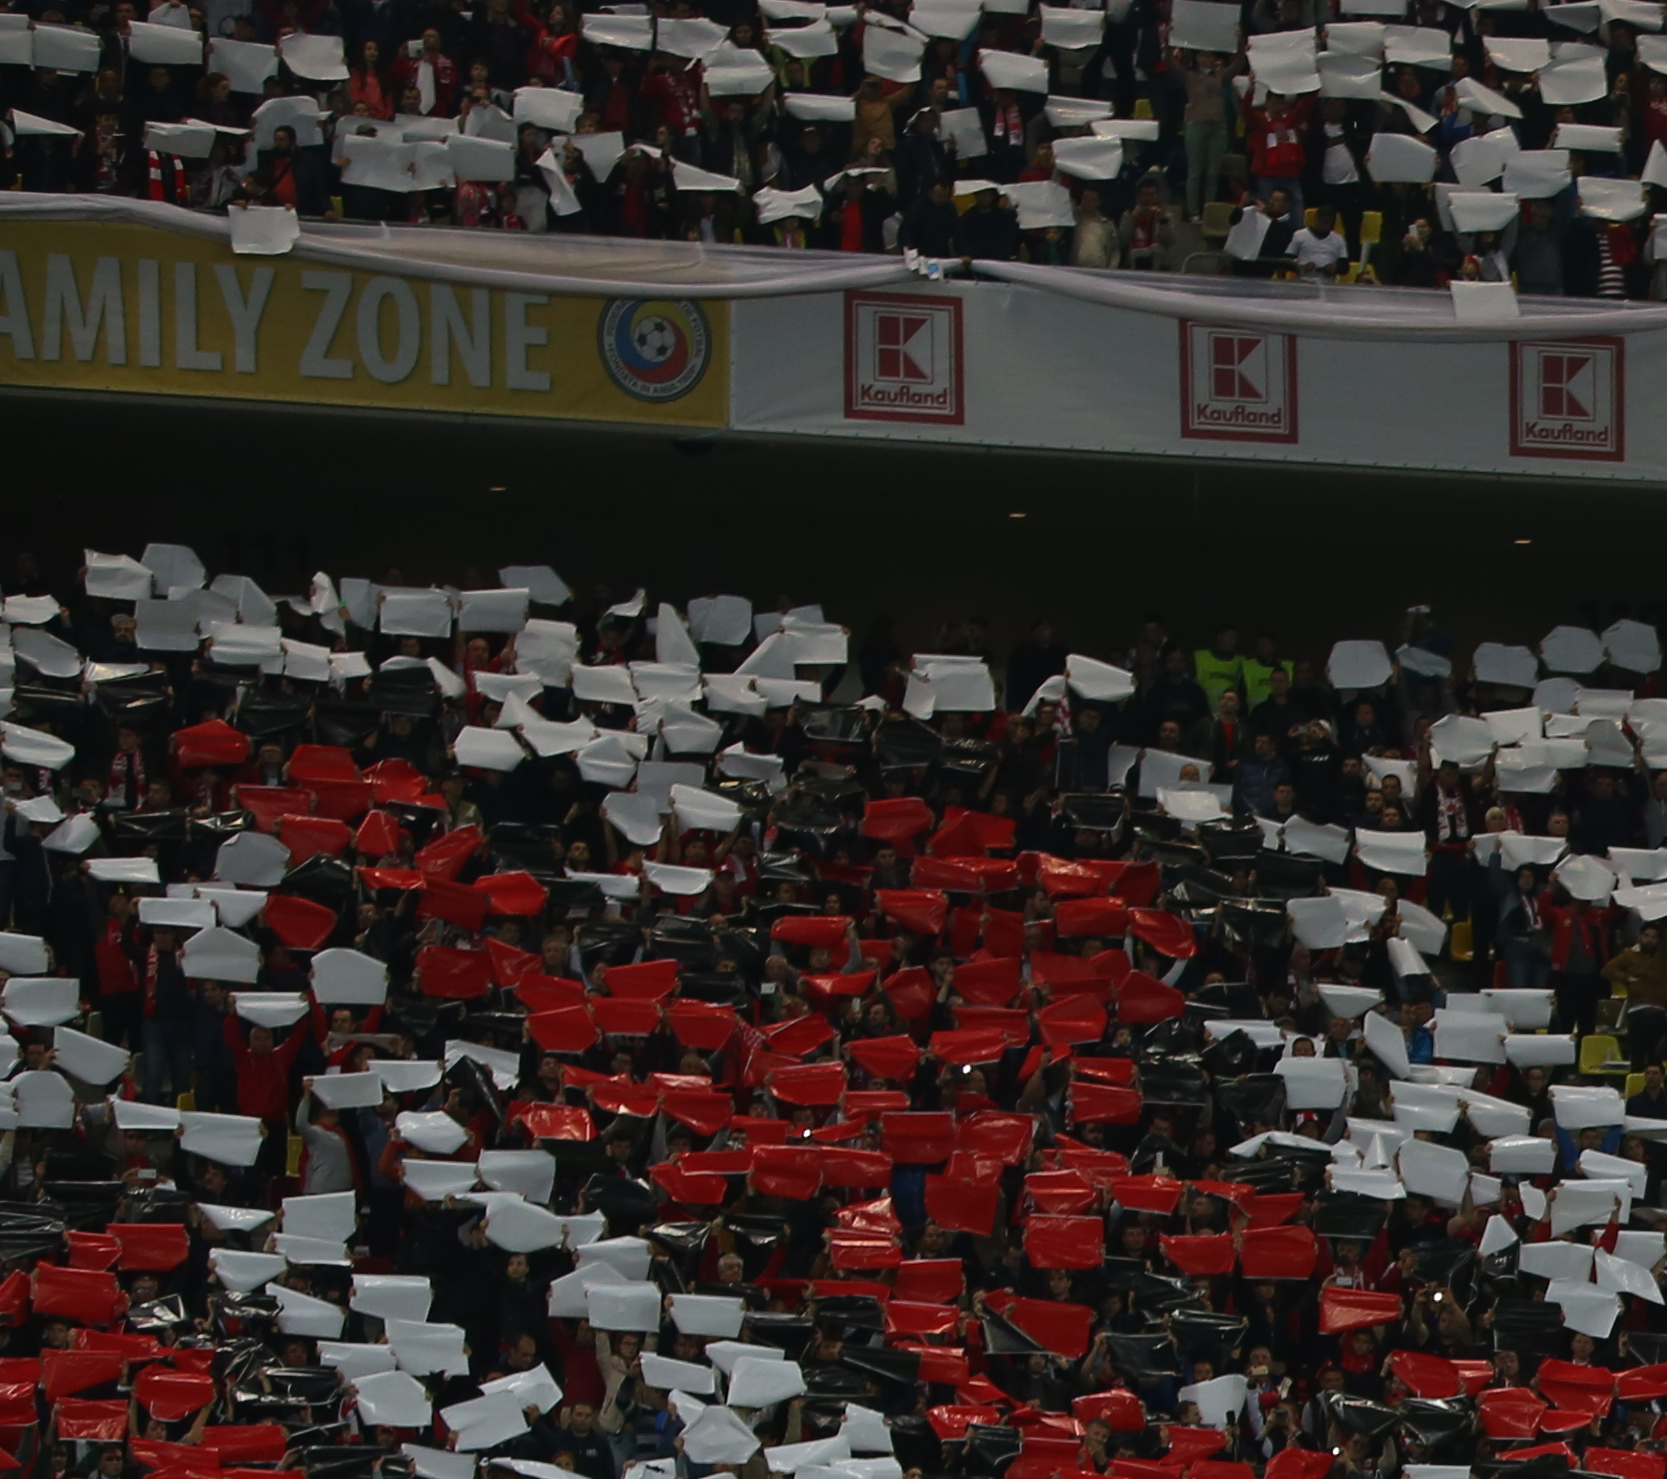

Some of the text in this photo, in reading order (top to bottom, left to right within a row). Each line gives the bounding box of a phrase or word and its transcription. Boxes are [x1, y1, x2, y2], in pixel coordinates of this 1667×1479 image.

[299, 270, 552, 391] ZONE
[859, 383, 949, 408] Kaufland
[1196, 402, 1283, 429] Kaufland
[1524, 420, 1610, 446] Kaufland
